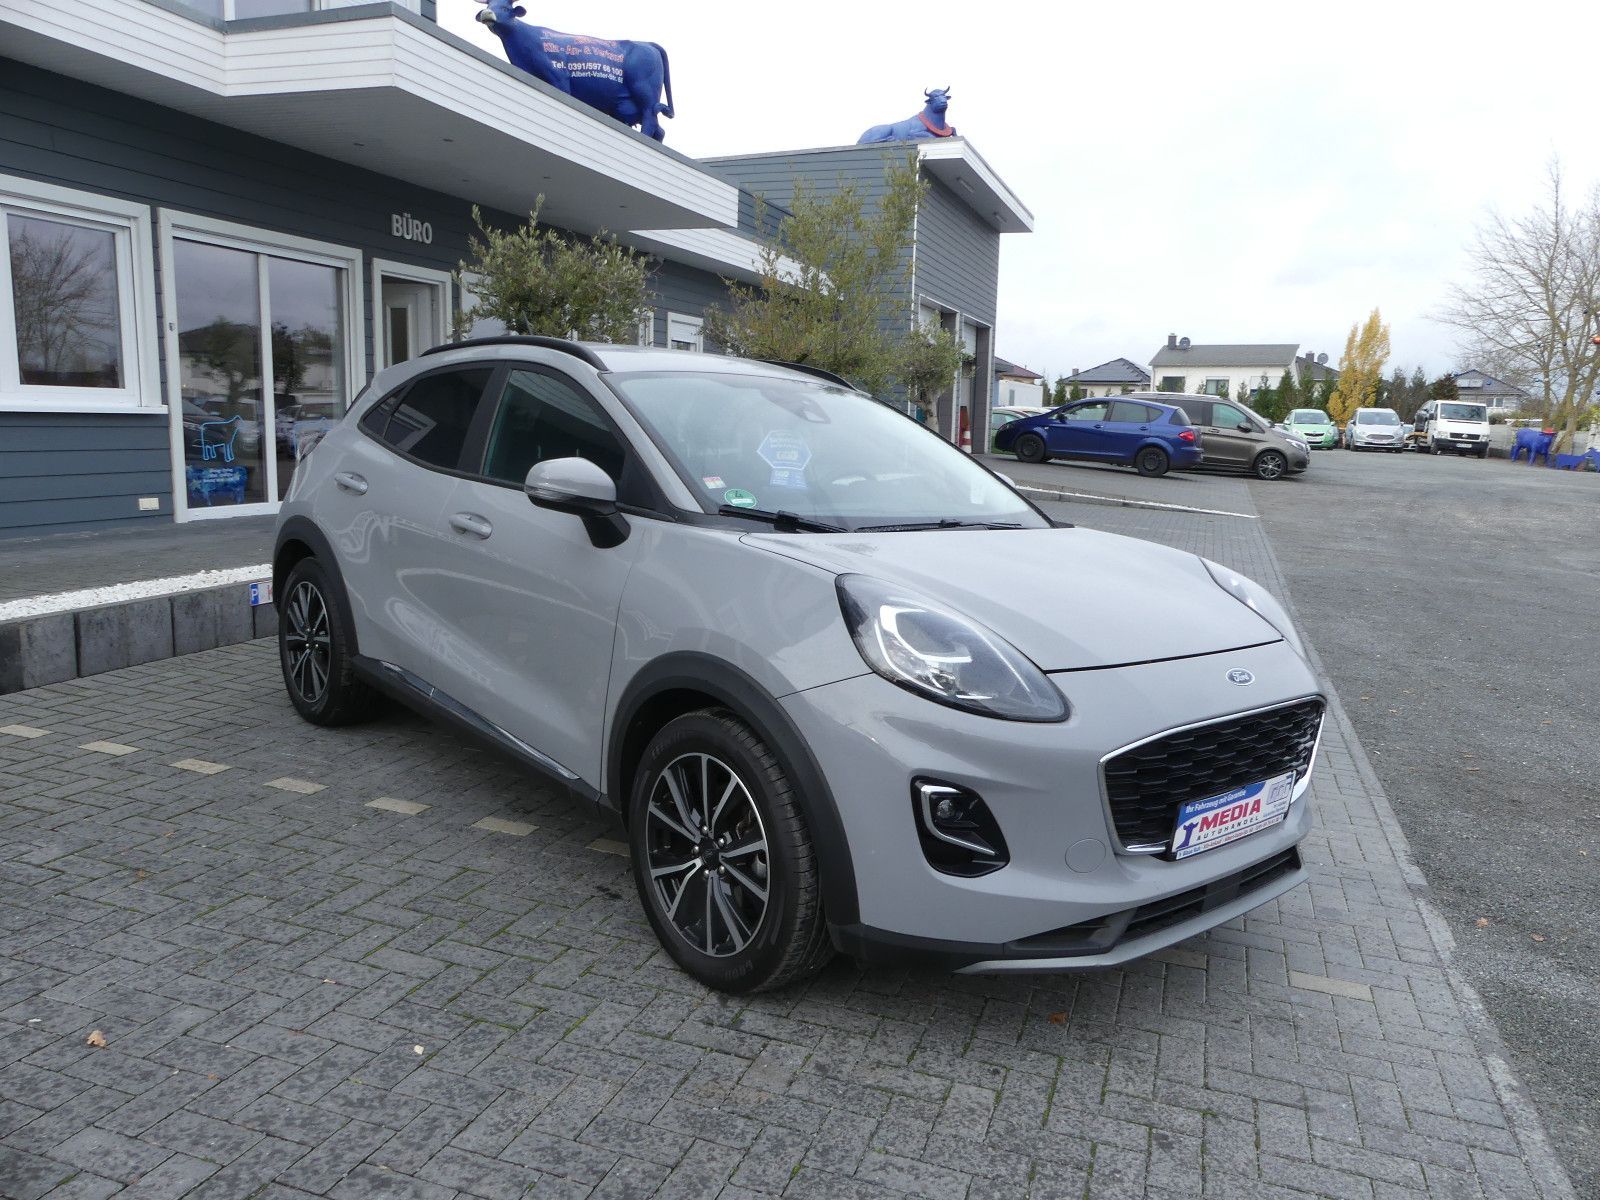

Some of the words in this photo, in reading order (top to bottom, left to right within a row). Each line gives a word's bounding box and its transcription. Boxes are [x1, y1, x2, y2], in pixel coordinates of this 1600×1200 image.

[551, 60, 566, 69] Tel.
[568, 62, 601, 70] 0391/597
[391, 212, 432, 244] BÜRO
[1197, 816, 1259, 841] AUTOHANDEL
[1199, 798, 1261, 832] MEDIA
